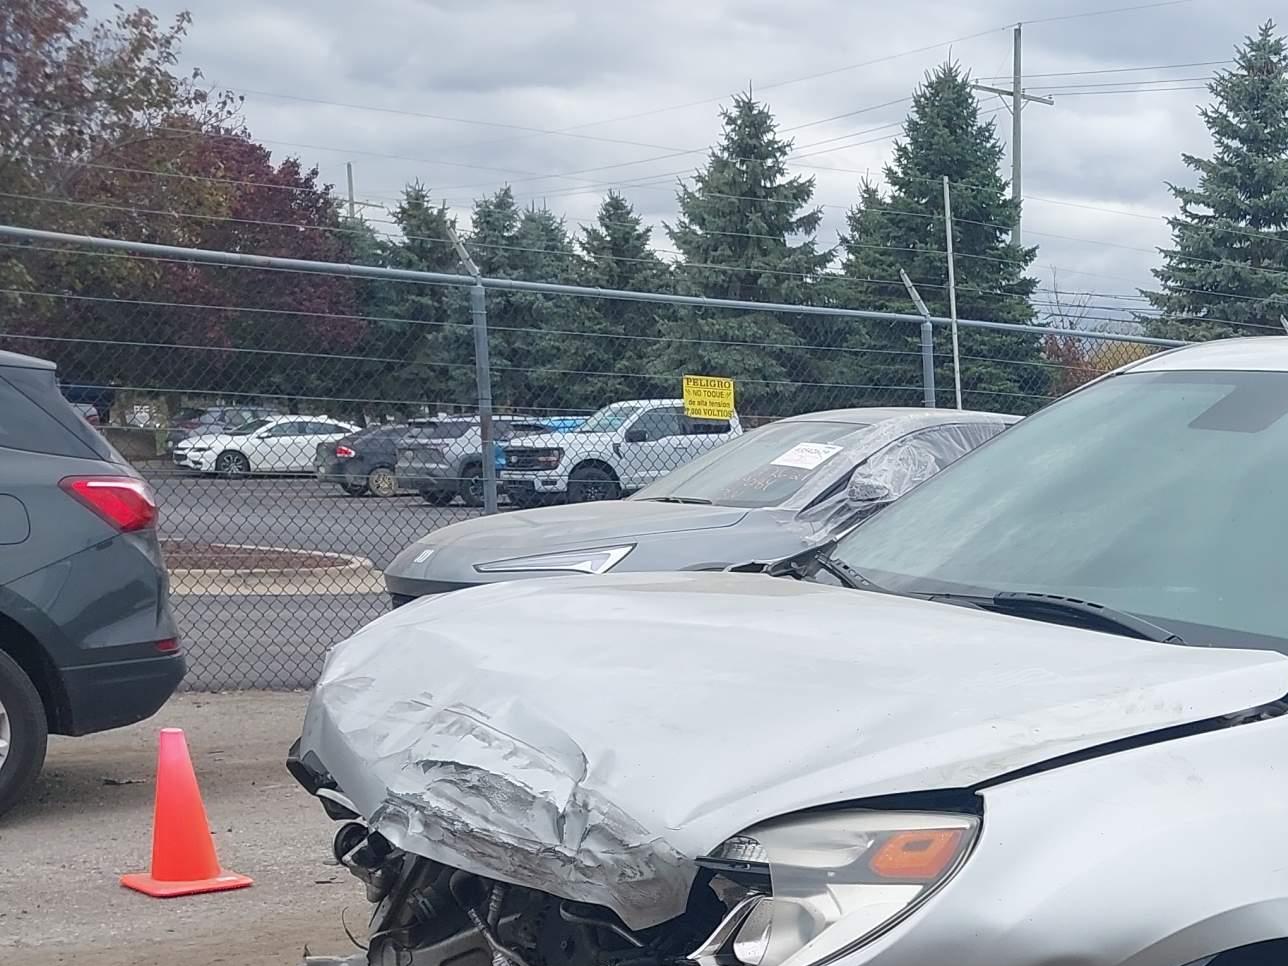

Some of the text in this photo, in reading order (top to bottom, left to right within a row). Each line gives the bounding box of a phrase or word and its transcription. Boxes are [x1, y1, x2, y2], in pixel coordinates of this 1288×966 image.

[686, 377, 731, 389] PELIGRO
[703, 390, 725, 398] TOQUE
[702, 408, 732, 417] VOLTIOS
